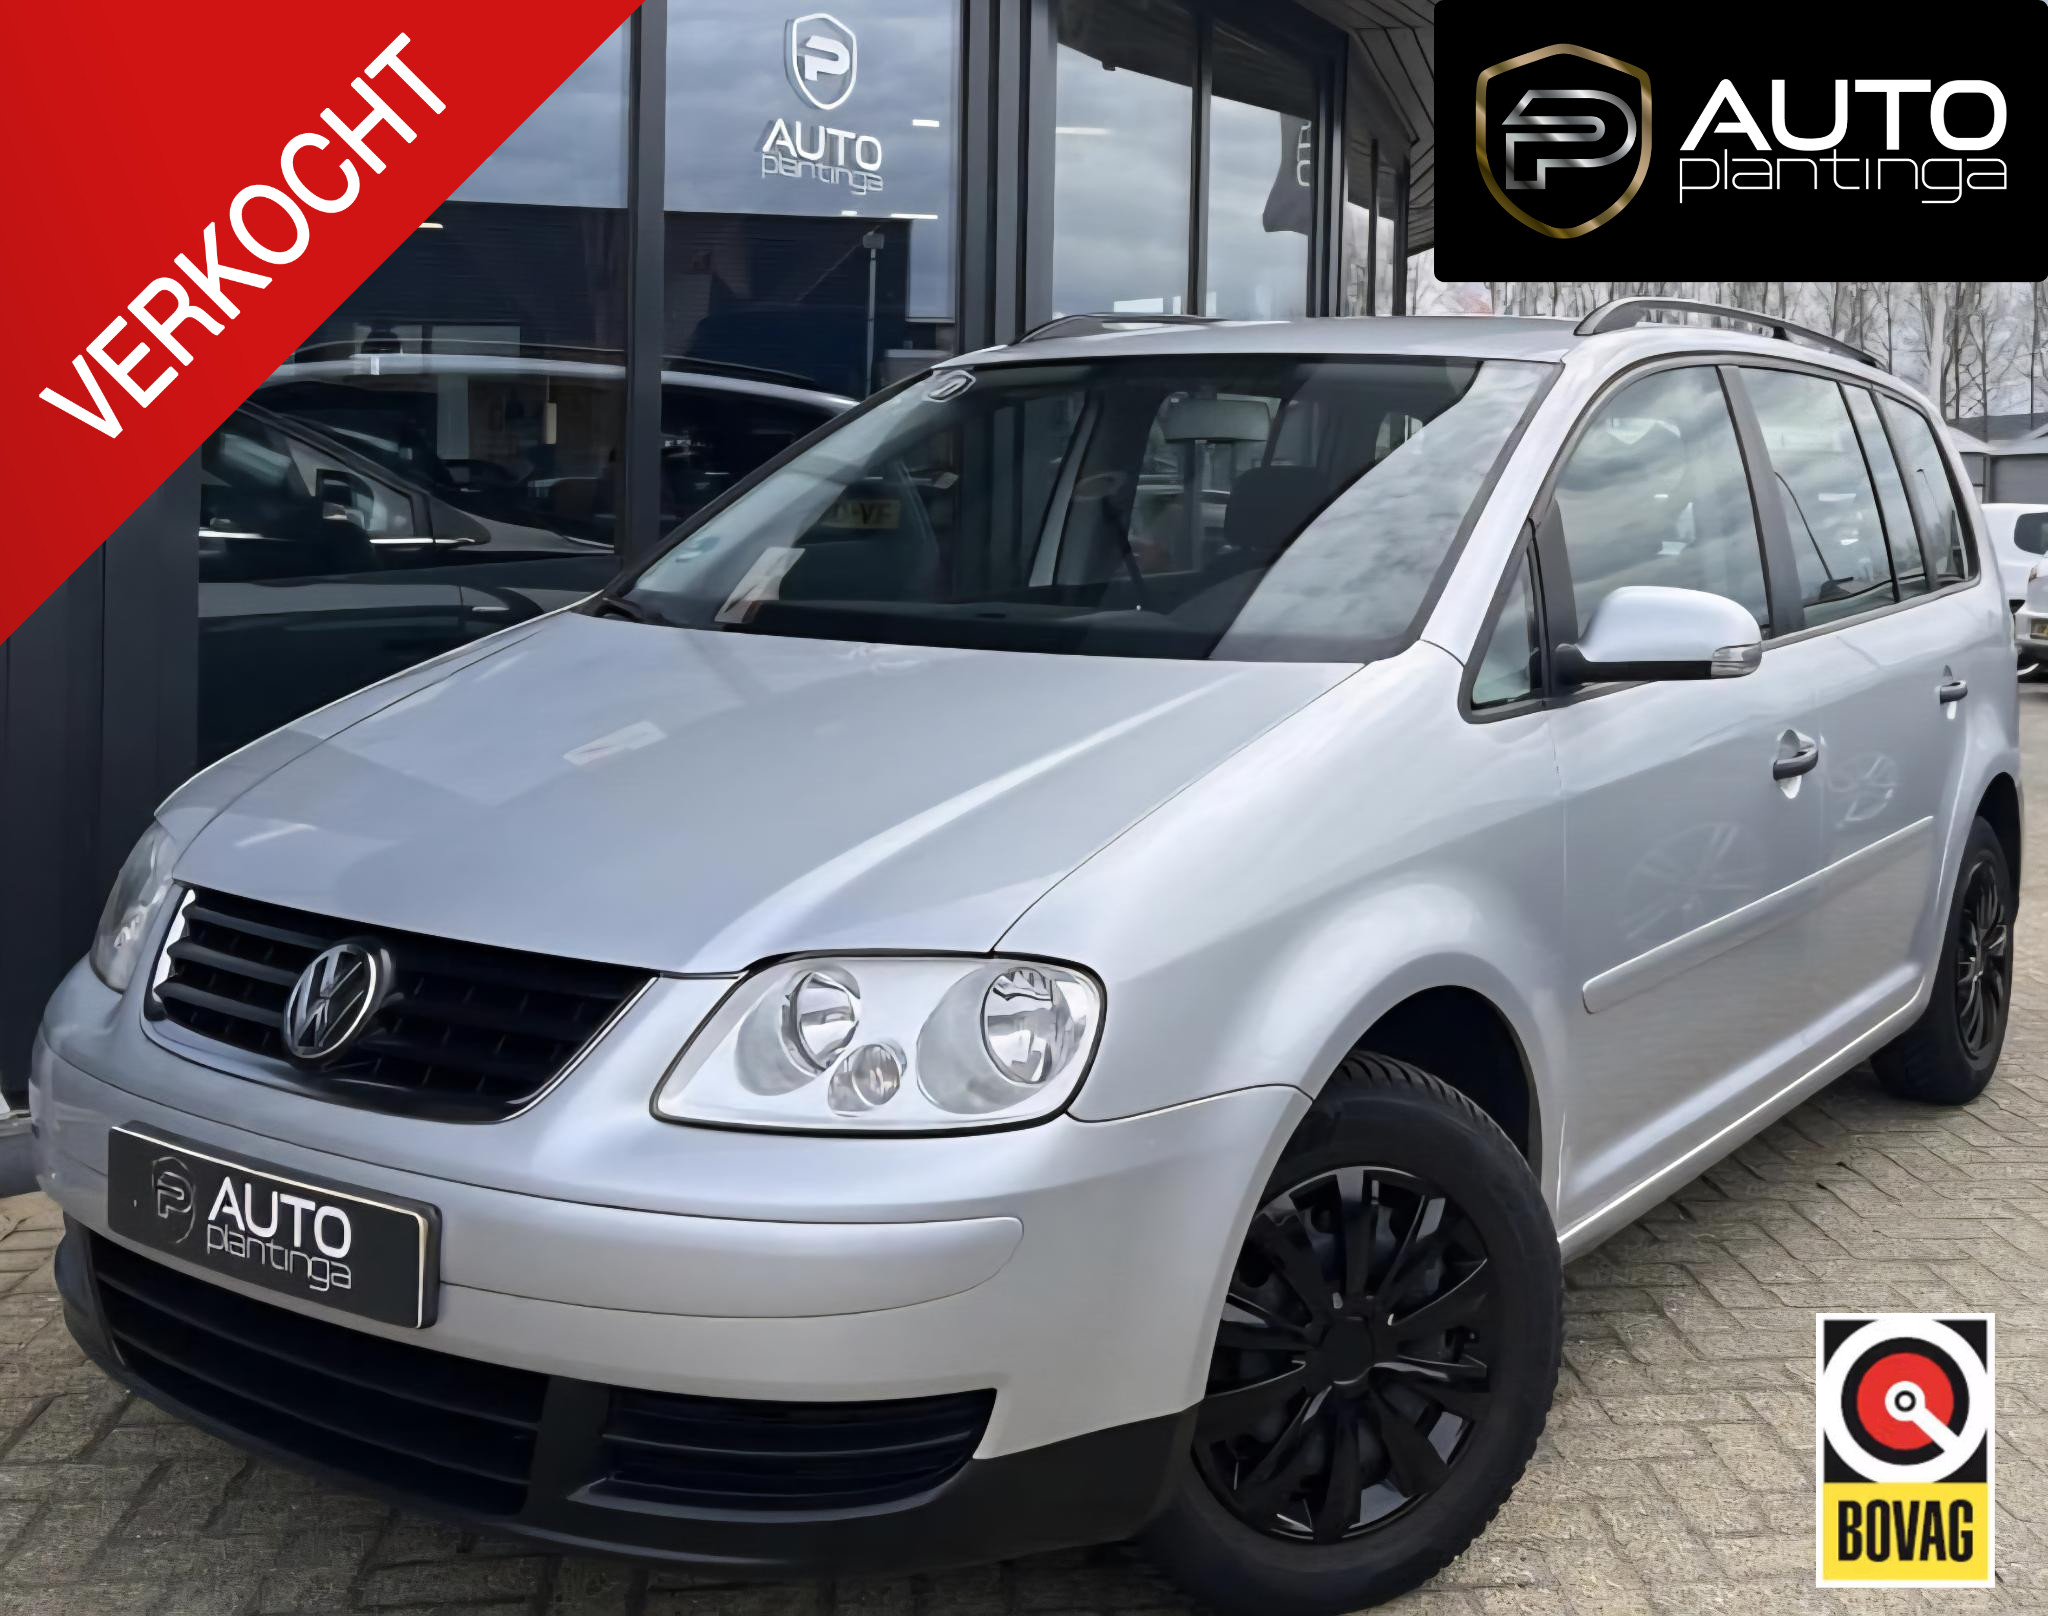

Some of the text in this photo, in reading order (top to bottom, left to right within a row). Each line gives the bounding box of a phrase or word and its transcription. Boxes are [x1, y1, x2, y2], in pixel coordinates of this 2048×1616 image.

[761, 151, 884, 196] plantinga
[762, 118, 883, 171] AUTO
[208, 1176, 352, 1259] AUTO
[206, 1223, 352, 1292] plantinga
